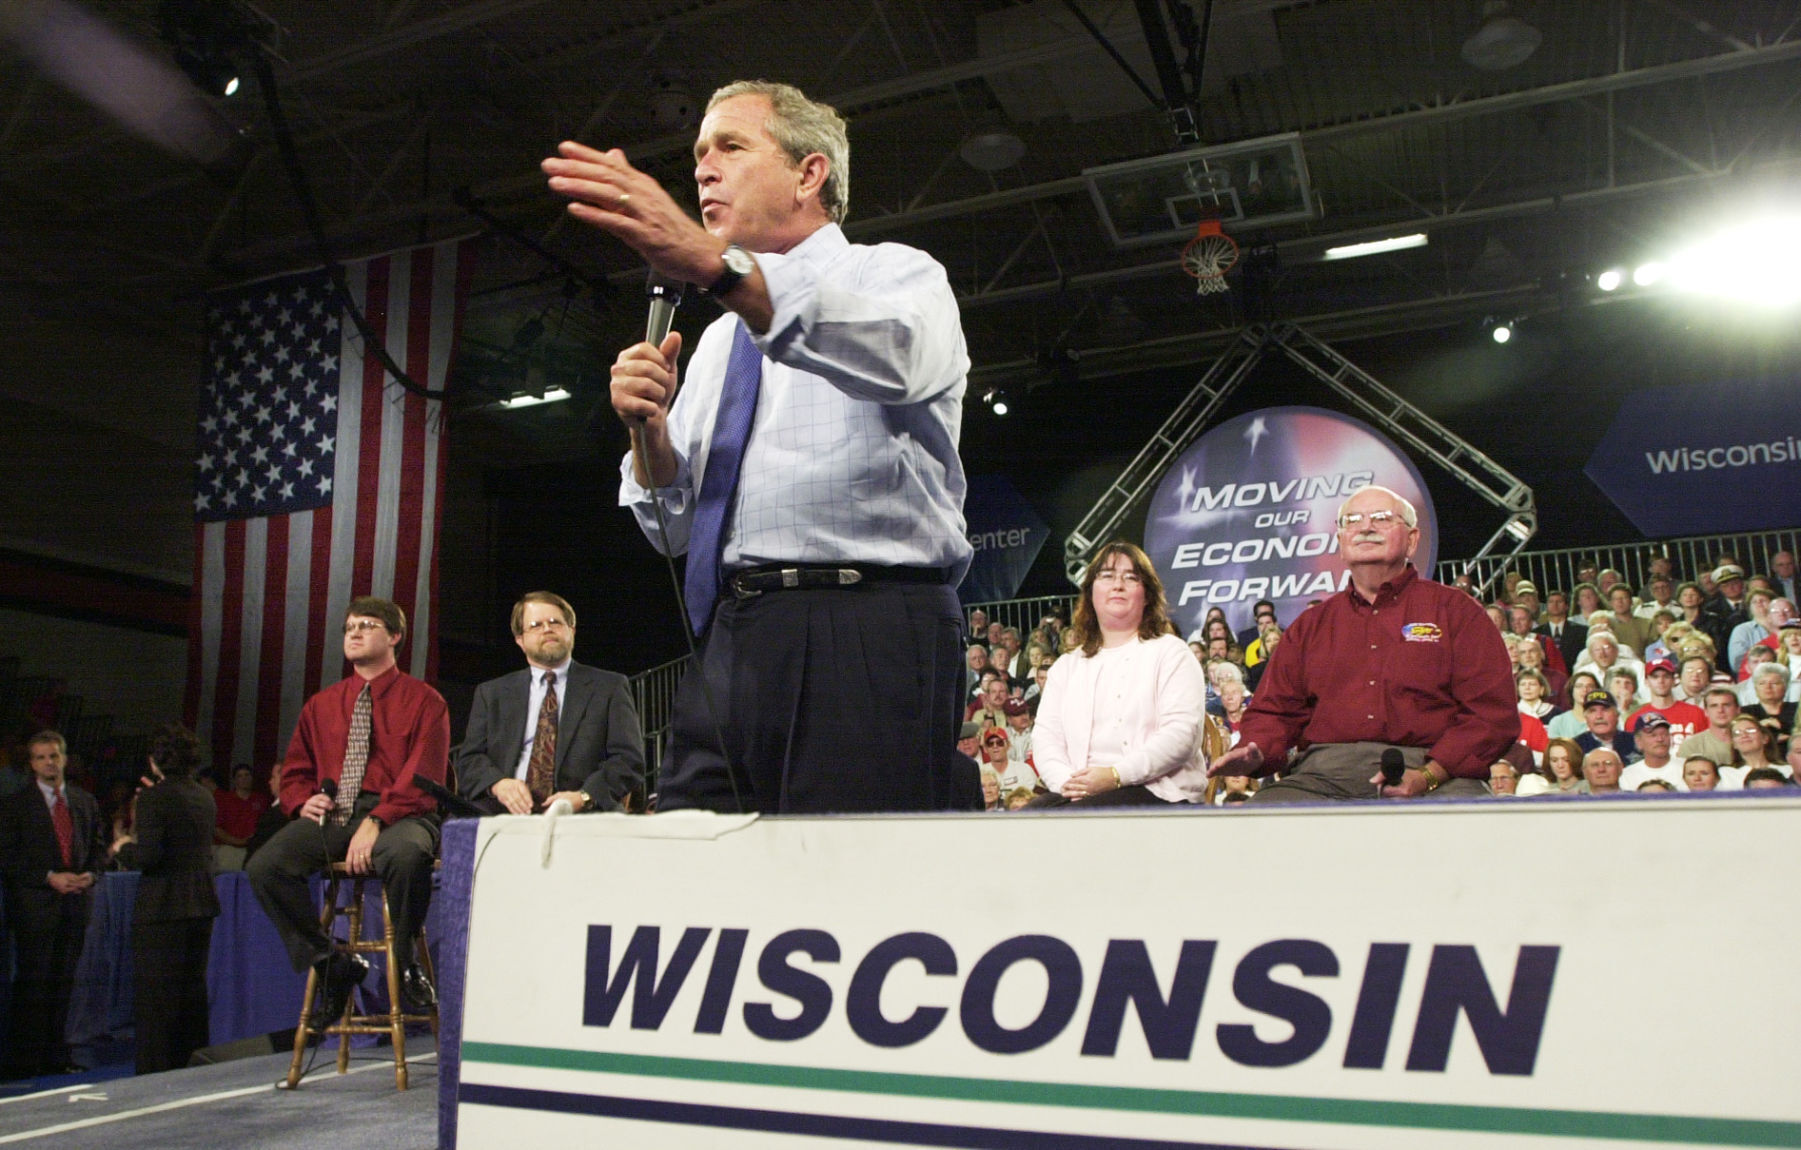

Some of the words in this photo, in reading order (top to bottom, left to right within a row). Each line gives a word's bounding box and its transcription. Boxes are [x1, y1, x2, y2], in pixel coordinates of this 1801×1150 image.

[1646, 437, 1801, 474] Wisconsi
[1192, 472, 1373, 511] MOVING
[1255, 510, 1310, 528] OUR
[968, 528, 1030, 551] enter
[583, 924, 1560, 1077] WISCONSIN
